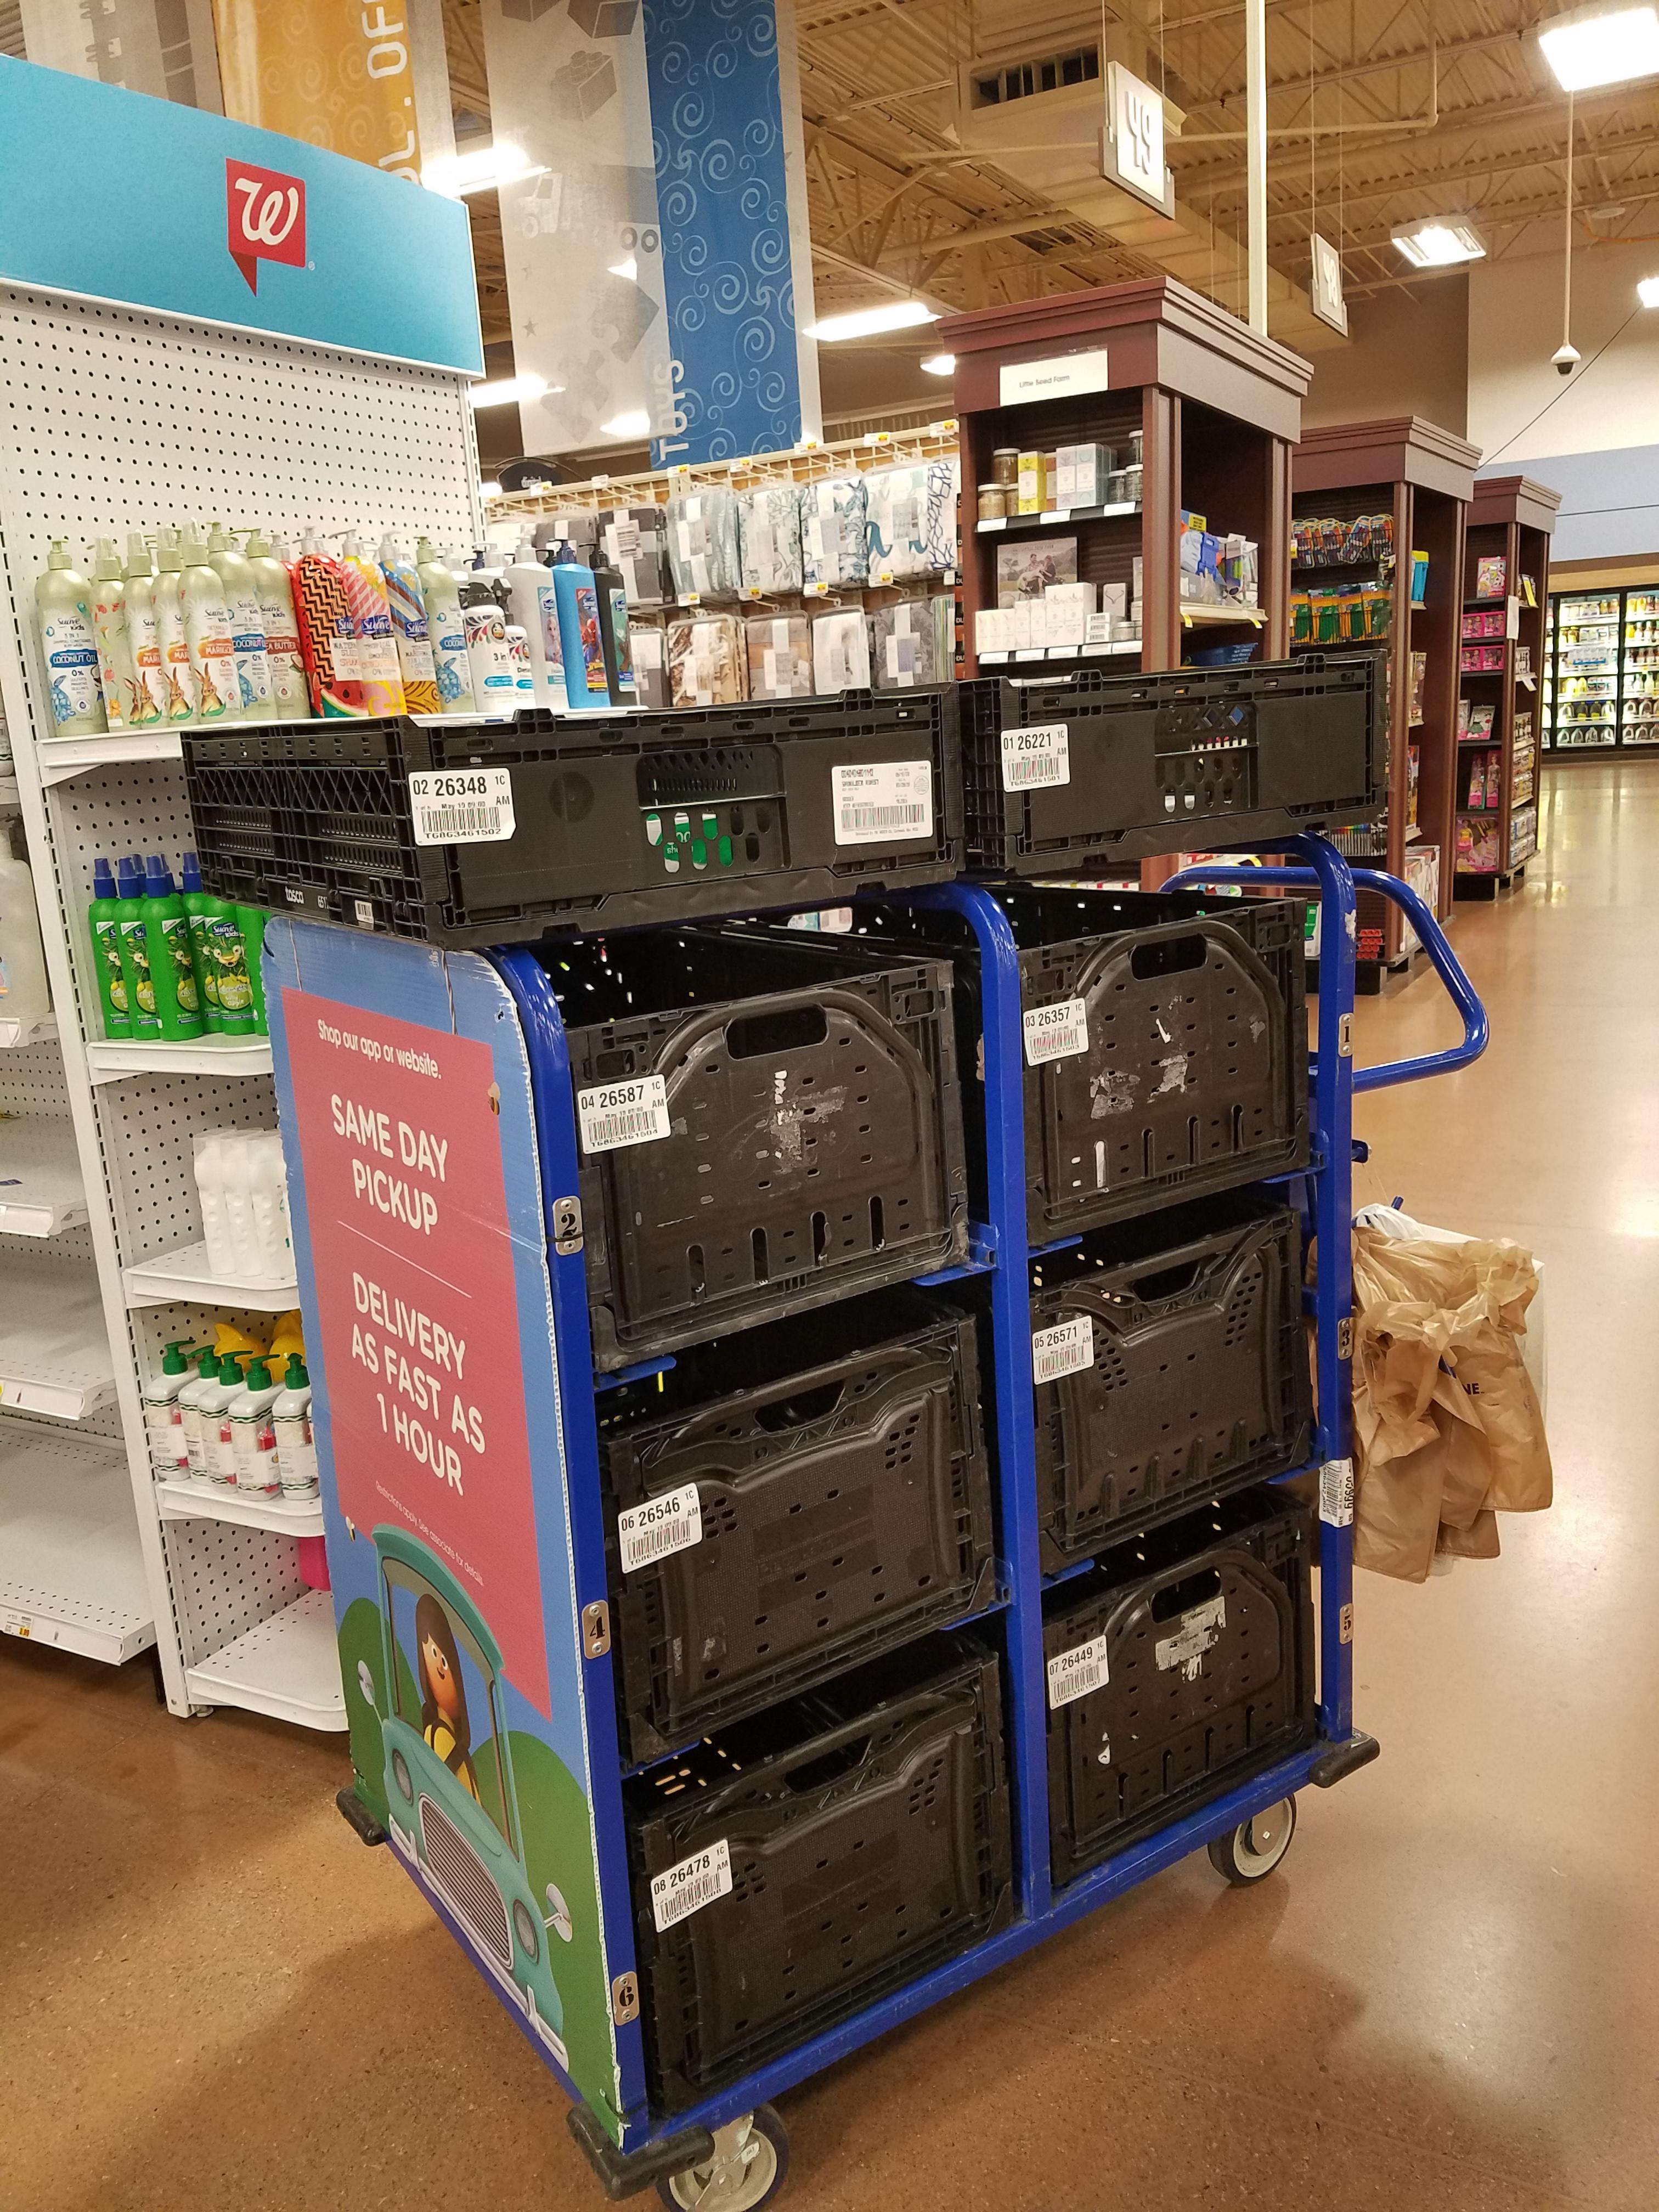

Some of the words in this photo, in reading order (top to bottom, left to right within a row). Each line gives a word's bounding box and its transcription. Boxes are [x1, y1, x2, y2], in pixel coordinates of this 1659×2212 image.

[361, 0, 407, 78] OF
[1125, 91, 1152, 175] 49
[234, 177, 299, 245] W
[1323, 252, 1338, 307] 48
[652, 360, 689, 461] TOYS
[363, 616, 390, 631] Suave
[53, 653, 84, 663] COCONUT
[86, 653, 97, 662] OIL
[1003, 737, 1013, 750] 01
[1018, 732, 1051, 751] 26221
[1057, 747, 1066, 755] AM
[413, 780, 429, 795] 02
[435, 776, 487, 796] 26348
[495, 775, 505, 785] 1C
[496, 795, 510, 805] AM
[285, 885, 304, 904] tosca
[213, 923, 235, 934] Suave
[1026, 1015, 1035, 1028] 03
[1038, 1007, 1070, 1026] 26357
[1344, 1026, 1350, 1043] 1
[343, 1032, 358, 1051] our
[360, 1037, 381, 1063] app
[383, 1045, 394, 1063] or
[396, 1046, 442, 1080] website.
[582, 1096, 594, 1110] 04
[600, 1085, 644, 1108] 26587
[652, 1081, 661, 1090] 1C
[652, 1098, 664, 1108] AM
[331, 1094, 394, 1158] SAME
[398, 1121, 448, 1182] DAY
[352, 1159, 438, 1235] PICKUP
[561, 1213, 577, 1237] 2
[353, 1272, 465, 1380] DELIVERY
[1035, 1336, 1044, 1348] 05
[1047, 1325, 1077, 1347] 26571
[1342, 1329, 1350, 1346] 3
[352, 1323, 379, 1374] AS
[385, 1345, 441, 1420] FAST
[452, 1395, 486, 1454] AS
[377, 1393, 387, 1433] 1
[393, 1404, 464, 1496] HOUR
[622, 1516, 634, 1531] 06
[639, 1497, 680, 1527] 26546
[685, 1490, 694, 1500] 1C
[687, 1506, 698, 1518] AM
[589, 1616, 606, 1639] 4
[1344, 1613, 1352, 1630] 5
[1049, 1662, 1059, 1675] 07
[1061, 1646, 1093, 1672] 26449
[1097, 1654, 1106, 1662] AM
[654, 1879, 666, 1895] 08
[670, 1855, 710, 1888] 26478
[716, 1846, 724, 1856] 1C
[716, 1860, 729, 1872] AM
[619, 1987, 635, 2007] 6
